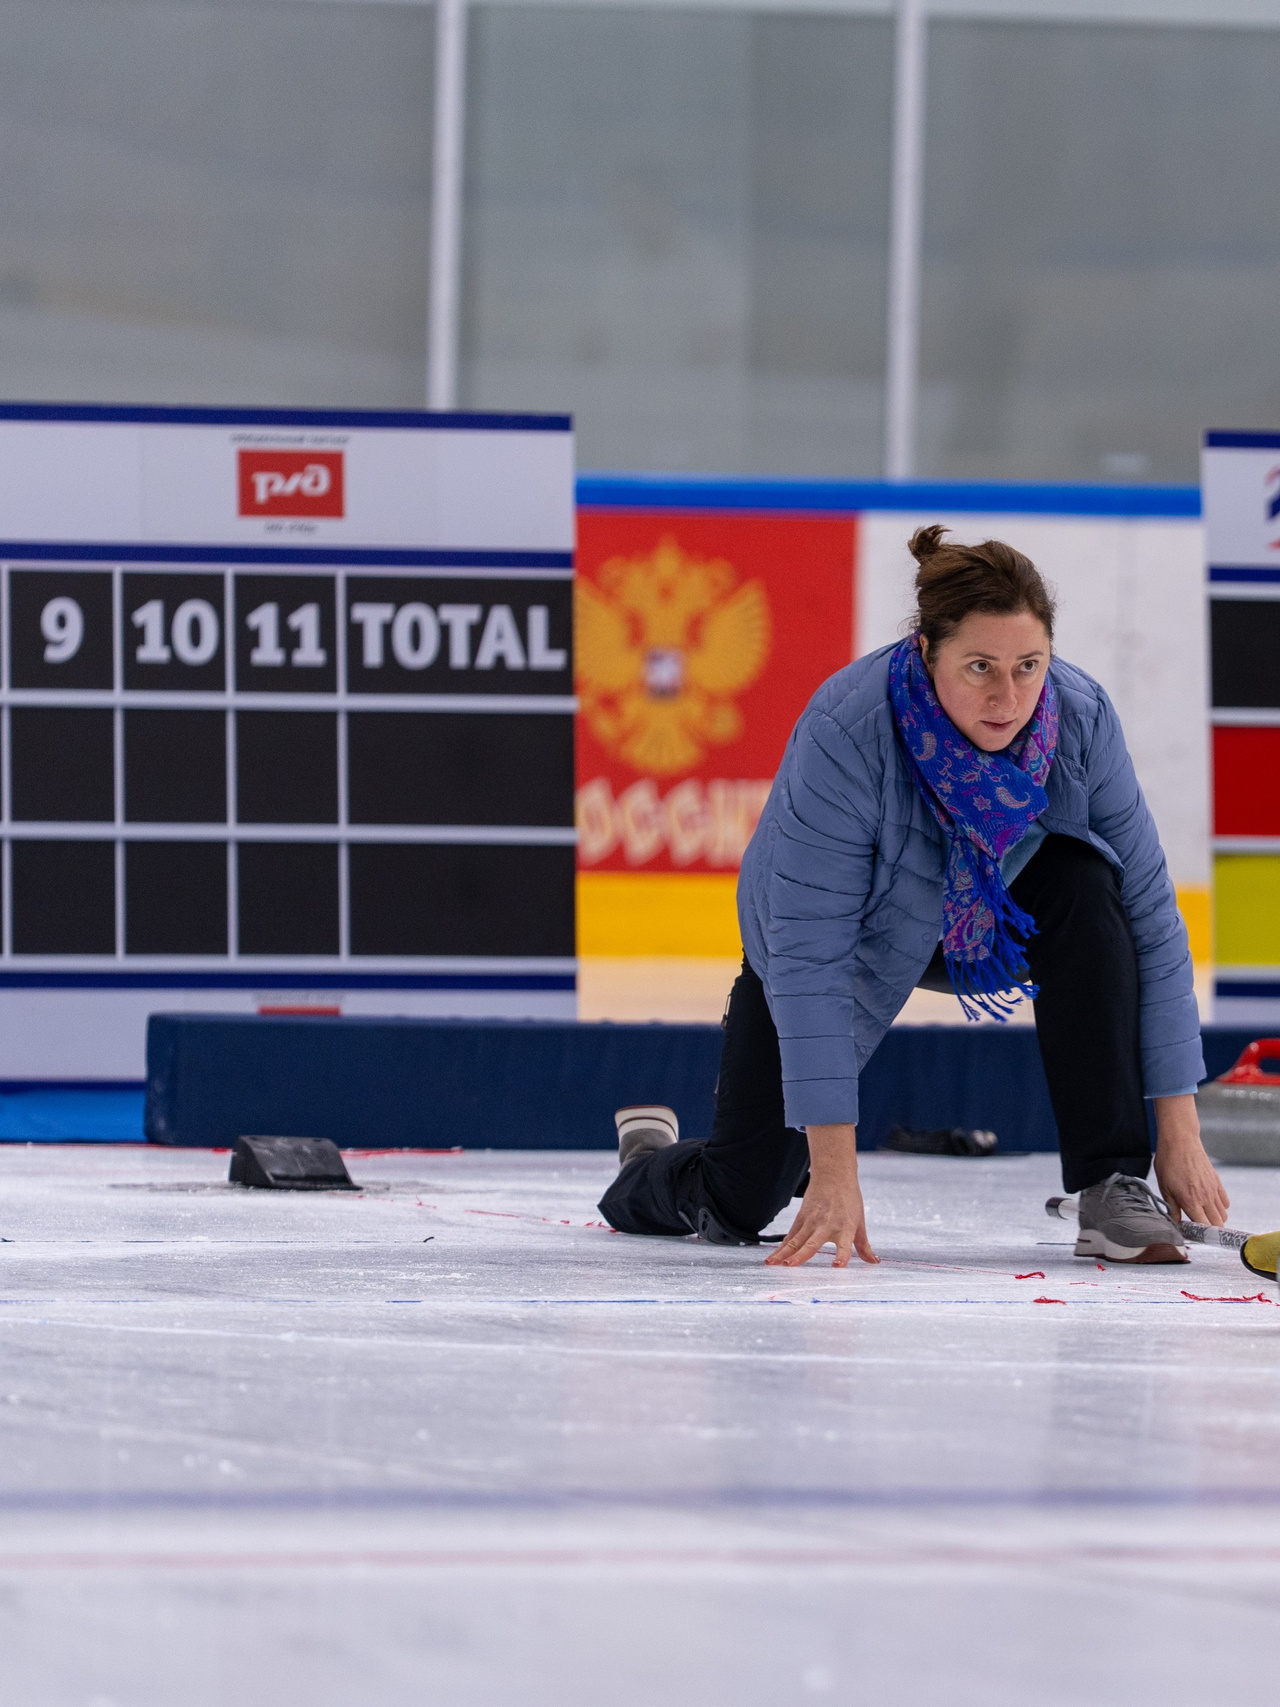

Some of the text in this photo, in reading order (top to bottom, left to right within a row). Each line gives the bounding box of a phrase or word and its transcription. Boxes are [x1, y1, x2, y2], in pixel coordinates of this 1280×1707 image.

[40, 597, 567, 670] 9 10 11 TOTAL
[576, 777, 777, 868] ОССИ
